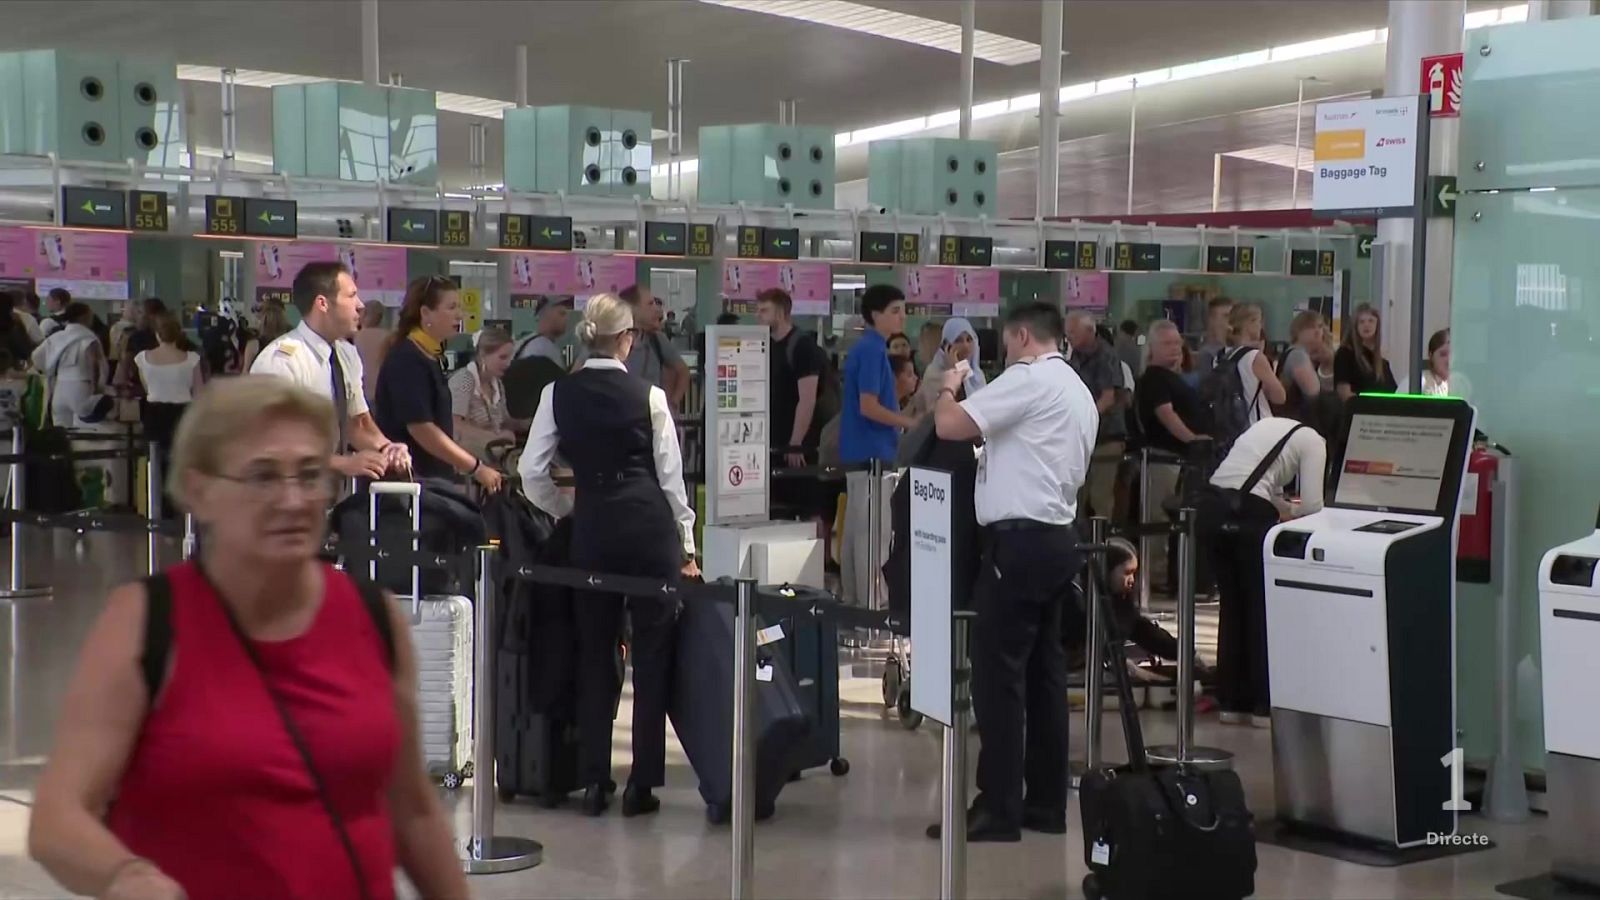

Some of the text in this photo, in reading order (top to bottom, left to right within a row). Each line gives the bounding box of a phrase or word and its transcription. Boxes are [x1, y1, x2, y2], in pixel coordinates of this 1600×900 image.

[1385, 137, 1406, 145] SWISS
[1320, 165, 1387, 180] Baggage Tag
[135, 214, 163, 228] 554
[211, 219, 238, 232] 555
[443, 231, 466, 244] 556
[503, 233, 524, 247] 557
[691, 242, 711, 256] 558
[741, 244, 760, 257] 559
[899, 250, 917, 262] 560
[914, 479, 945, 504] Bag Drop
